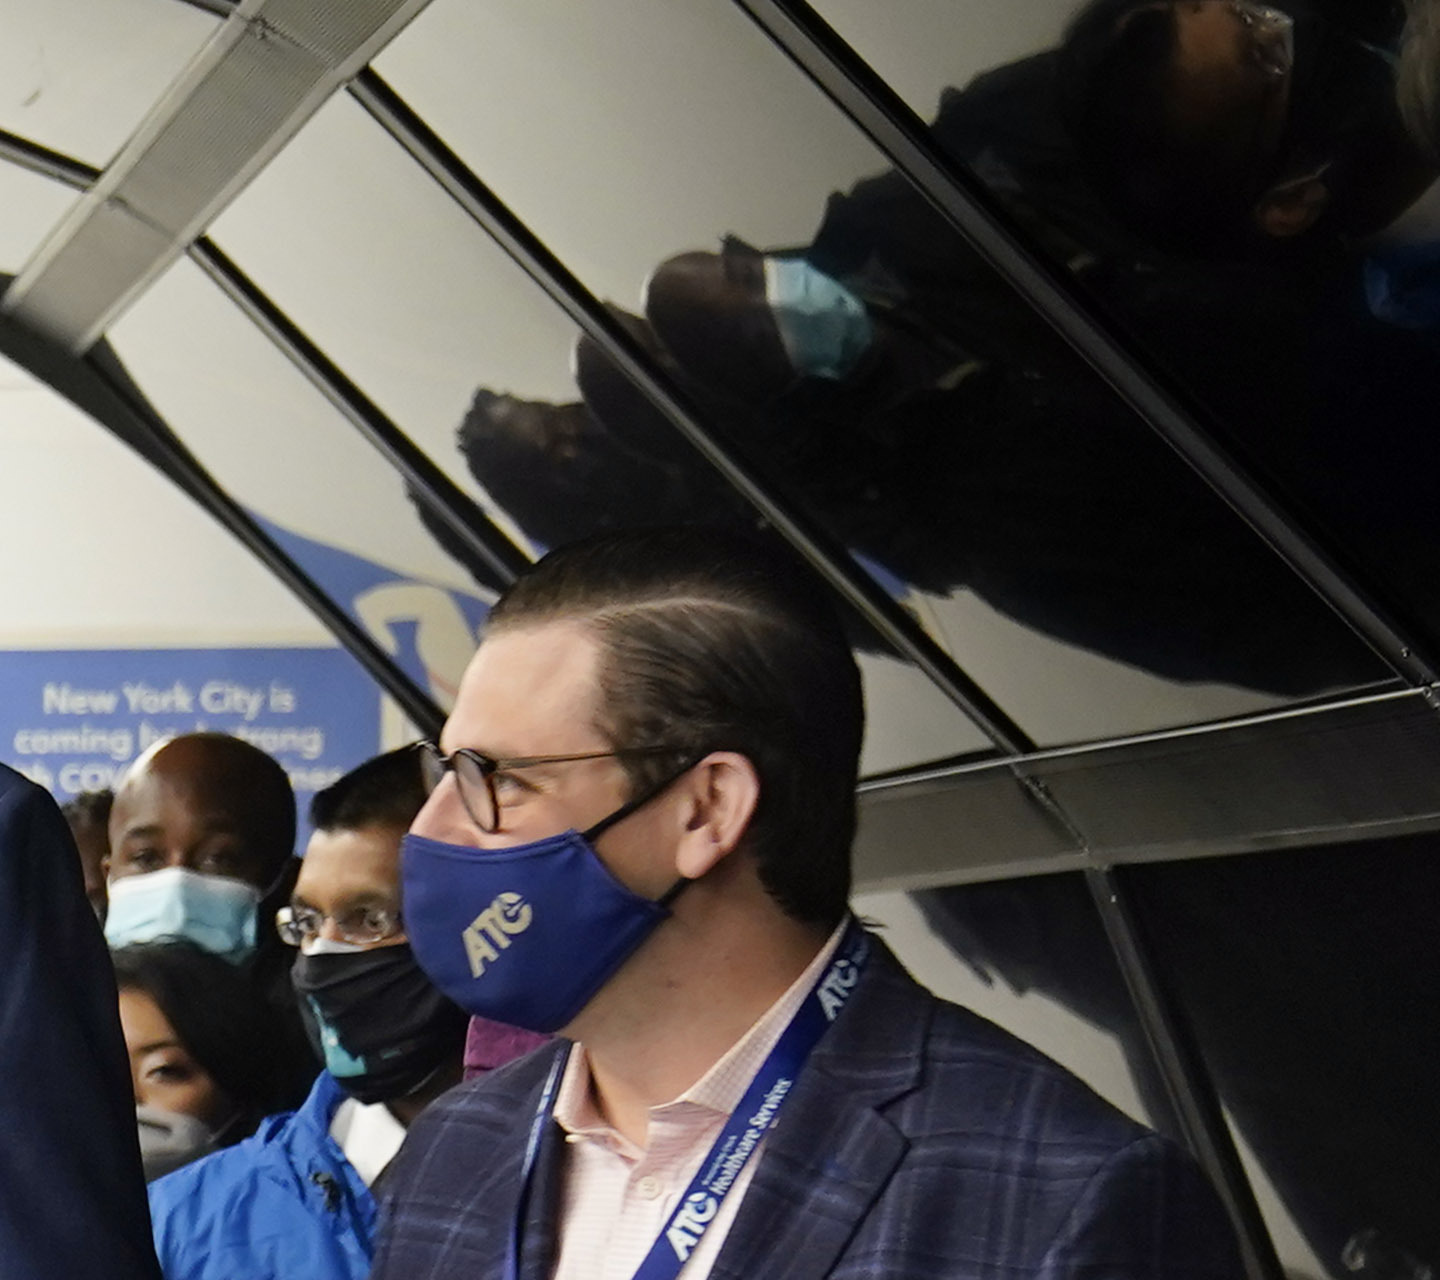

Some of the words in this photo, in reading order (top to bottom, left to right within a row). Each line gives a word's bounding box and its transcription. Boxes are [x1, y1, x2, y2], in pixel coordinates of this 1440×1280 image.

[43, 681, 118, 715] New
[123, 680, 193, 714] York
[199, 680, 265, 721] City
[269, 680, 296, 714] is
[13, 724, 133, 761] coming
[237, 726, 325, 760] rong
[462, 891, 533, 979] ATC
[666, 1191, 719, 1262] ATC
